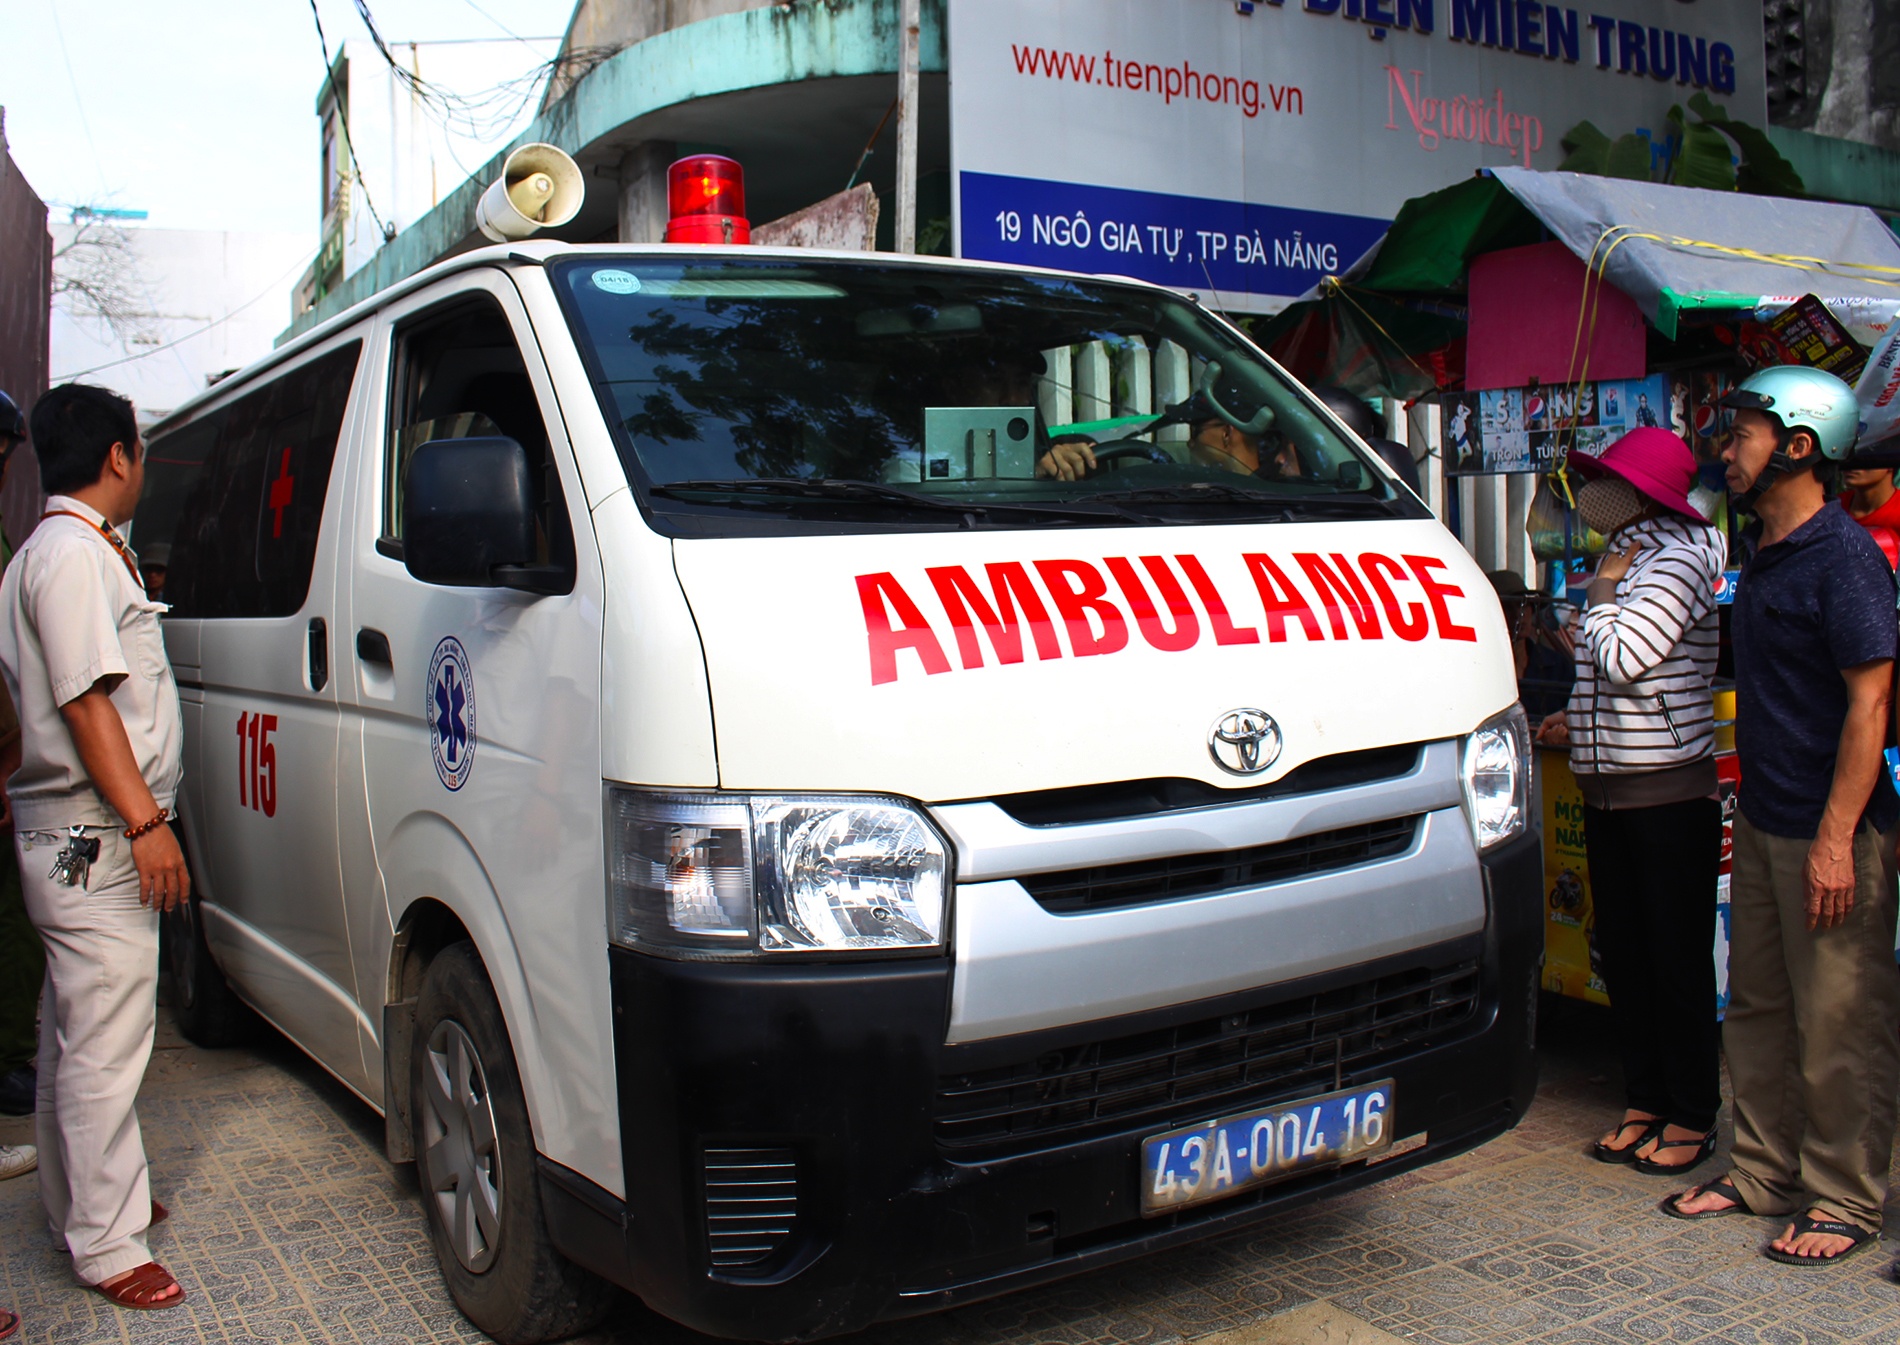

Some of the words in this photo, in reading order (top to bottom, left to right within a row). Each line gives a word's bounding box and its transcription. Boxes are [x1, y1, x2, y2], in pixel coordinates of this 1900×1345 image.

[1011, 43, 1304, 118] www.tienphong.vn
[1588, 14, 1735, 97] TRUNG
[995, 210, 1021, 242] 19
[1032, 211, 1091, 249] NGÔ
[1100, 221, 1143, 254] GIA
[1196, 231, 1227, 261] TP
[1234, 229, 1267, 266] ĐÀ
[1274, 230, 1338, 271] NẴNG
[854, 552, 1478, 686] AMBULANCE
[236, 710, 278, 818] 115
